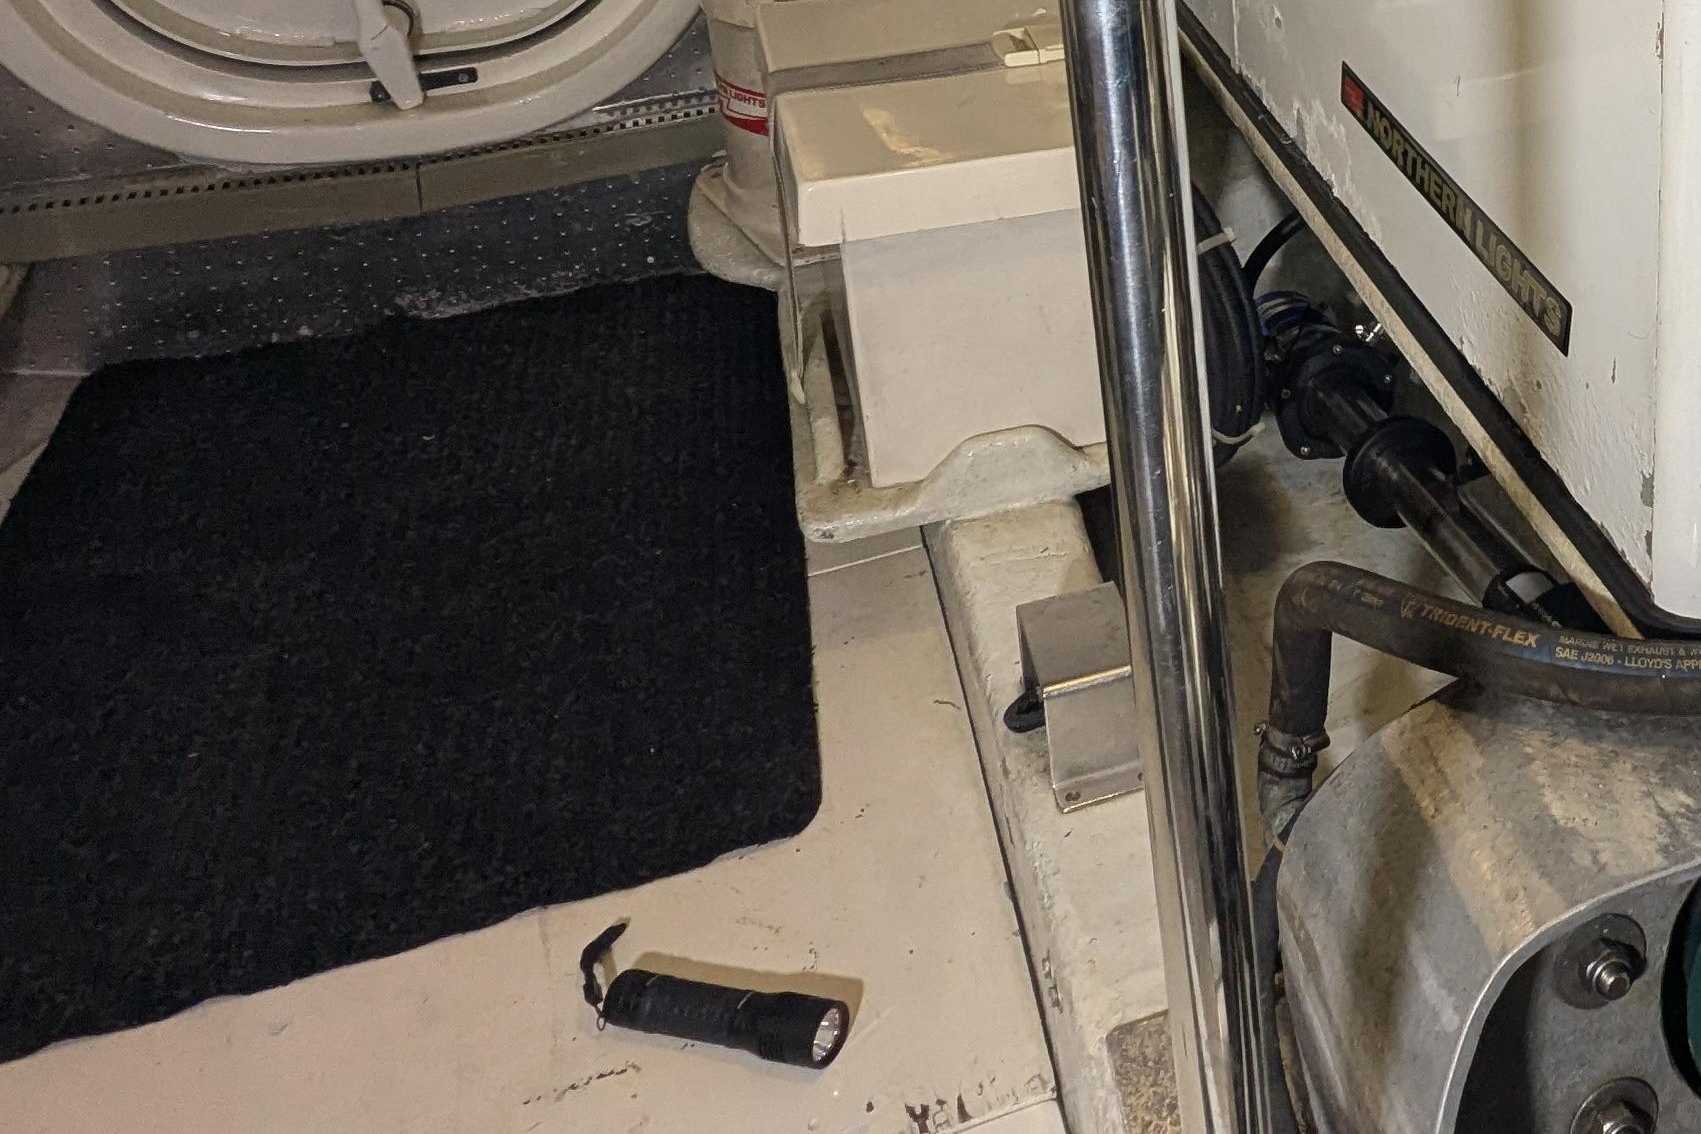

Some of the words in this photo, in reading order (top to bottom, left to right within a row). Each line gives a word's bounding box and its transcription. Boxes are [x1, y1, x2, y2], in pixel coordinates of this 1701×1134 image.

[729, 89, 767, 109] LIGHTS
[1367, 102, 1472, 241] NORTHERN
[1476, 221, 1562, 335] LIGHTS
[1554, 647, 1579, 661] SAE
[1624, 656, 1673, 670] LLOYD'S
